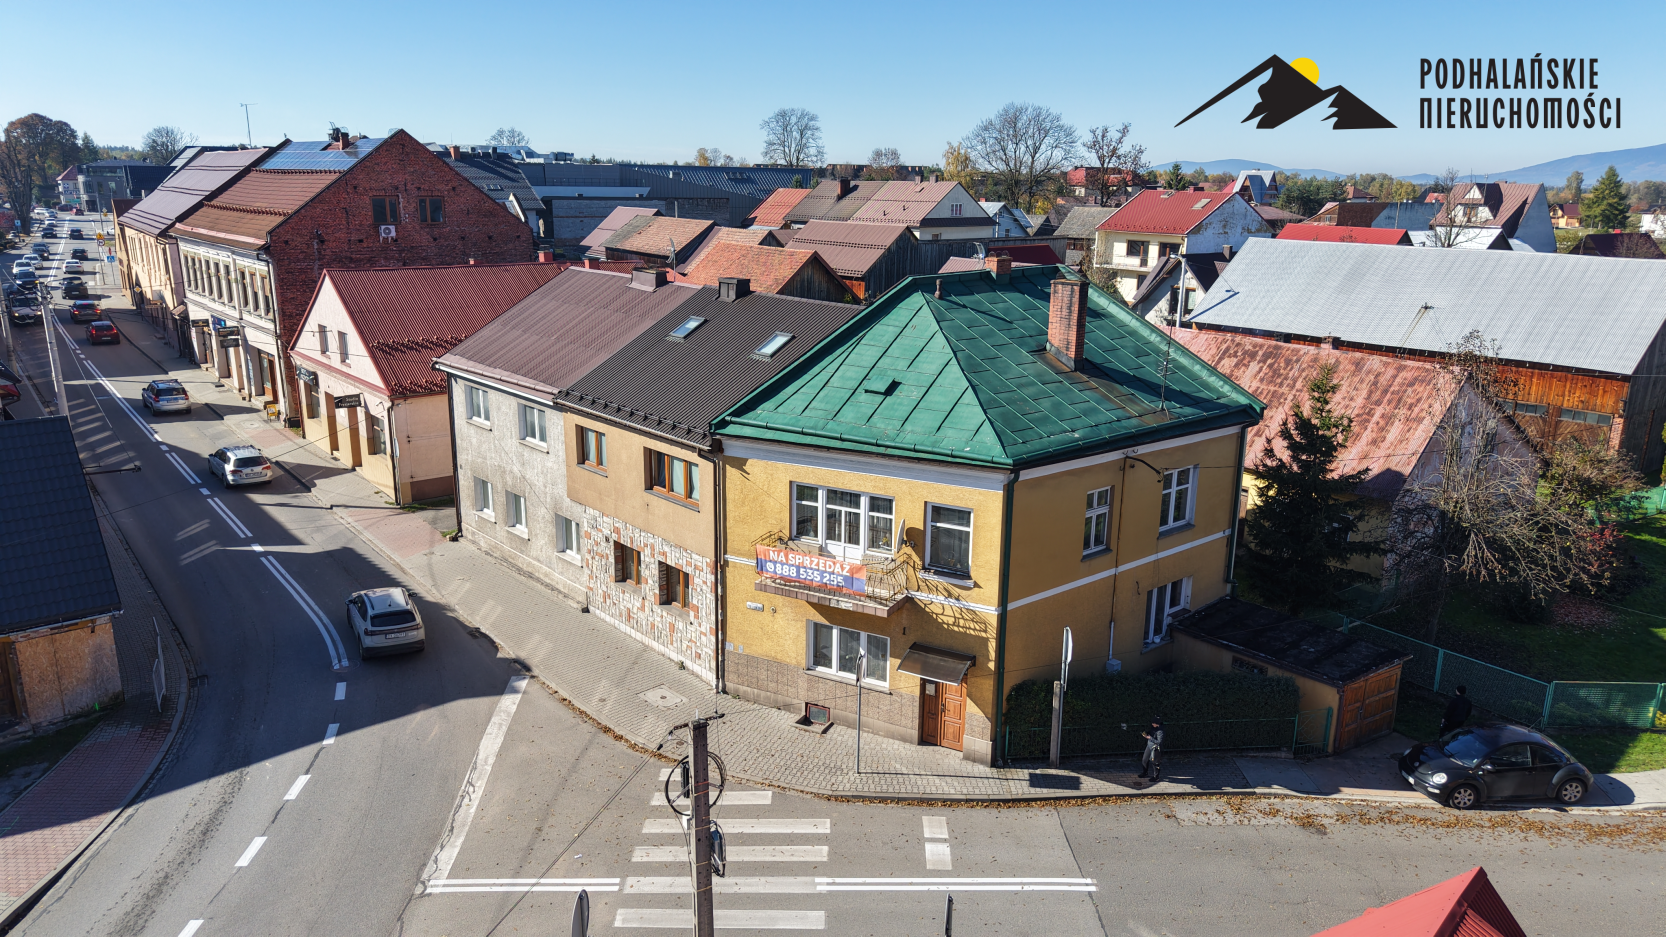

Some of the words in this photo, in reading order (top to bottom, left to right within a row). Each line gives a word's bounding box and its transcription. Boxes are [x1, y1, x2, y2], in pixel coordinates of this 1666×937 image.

[769, 550, 786, 563] NA
[788, 553, 850, 576] SPRZEDAŻ
[775, 563, 797, 577] 888
[800, 568, 820, 582] 535
[822, 573, 845, 586] 255
